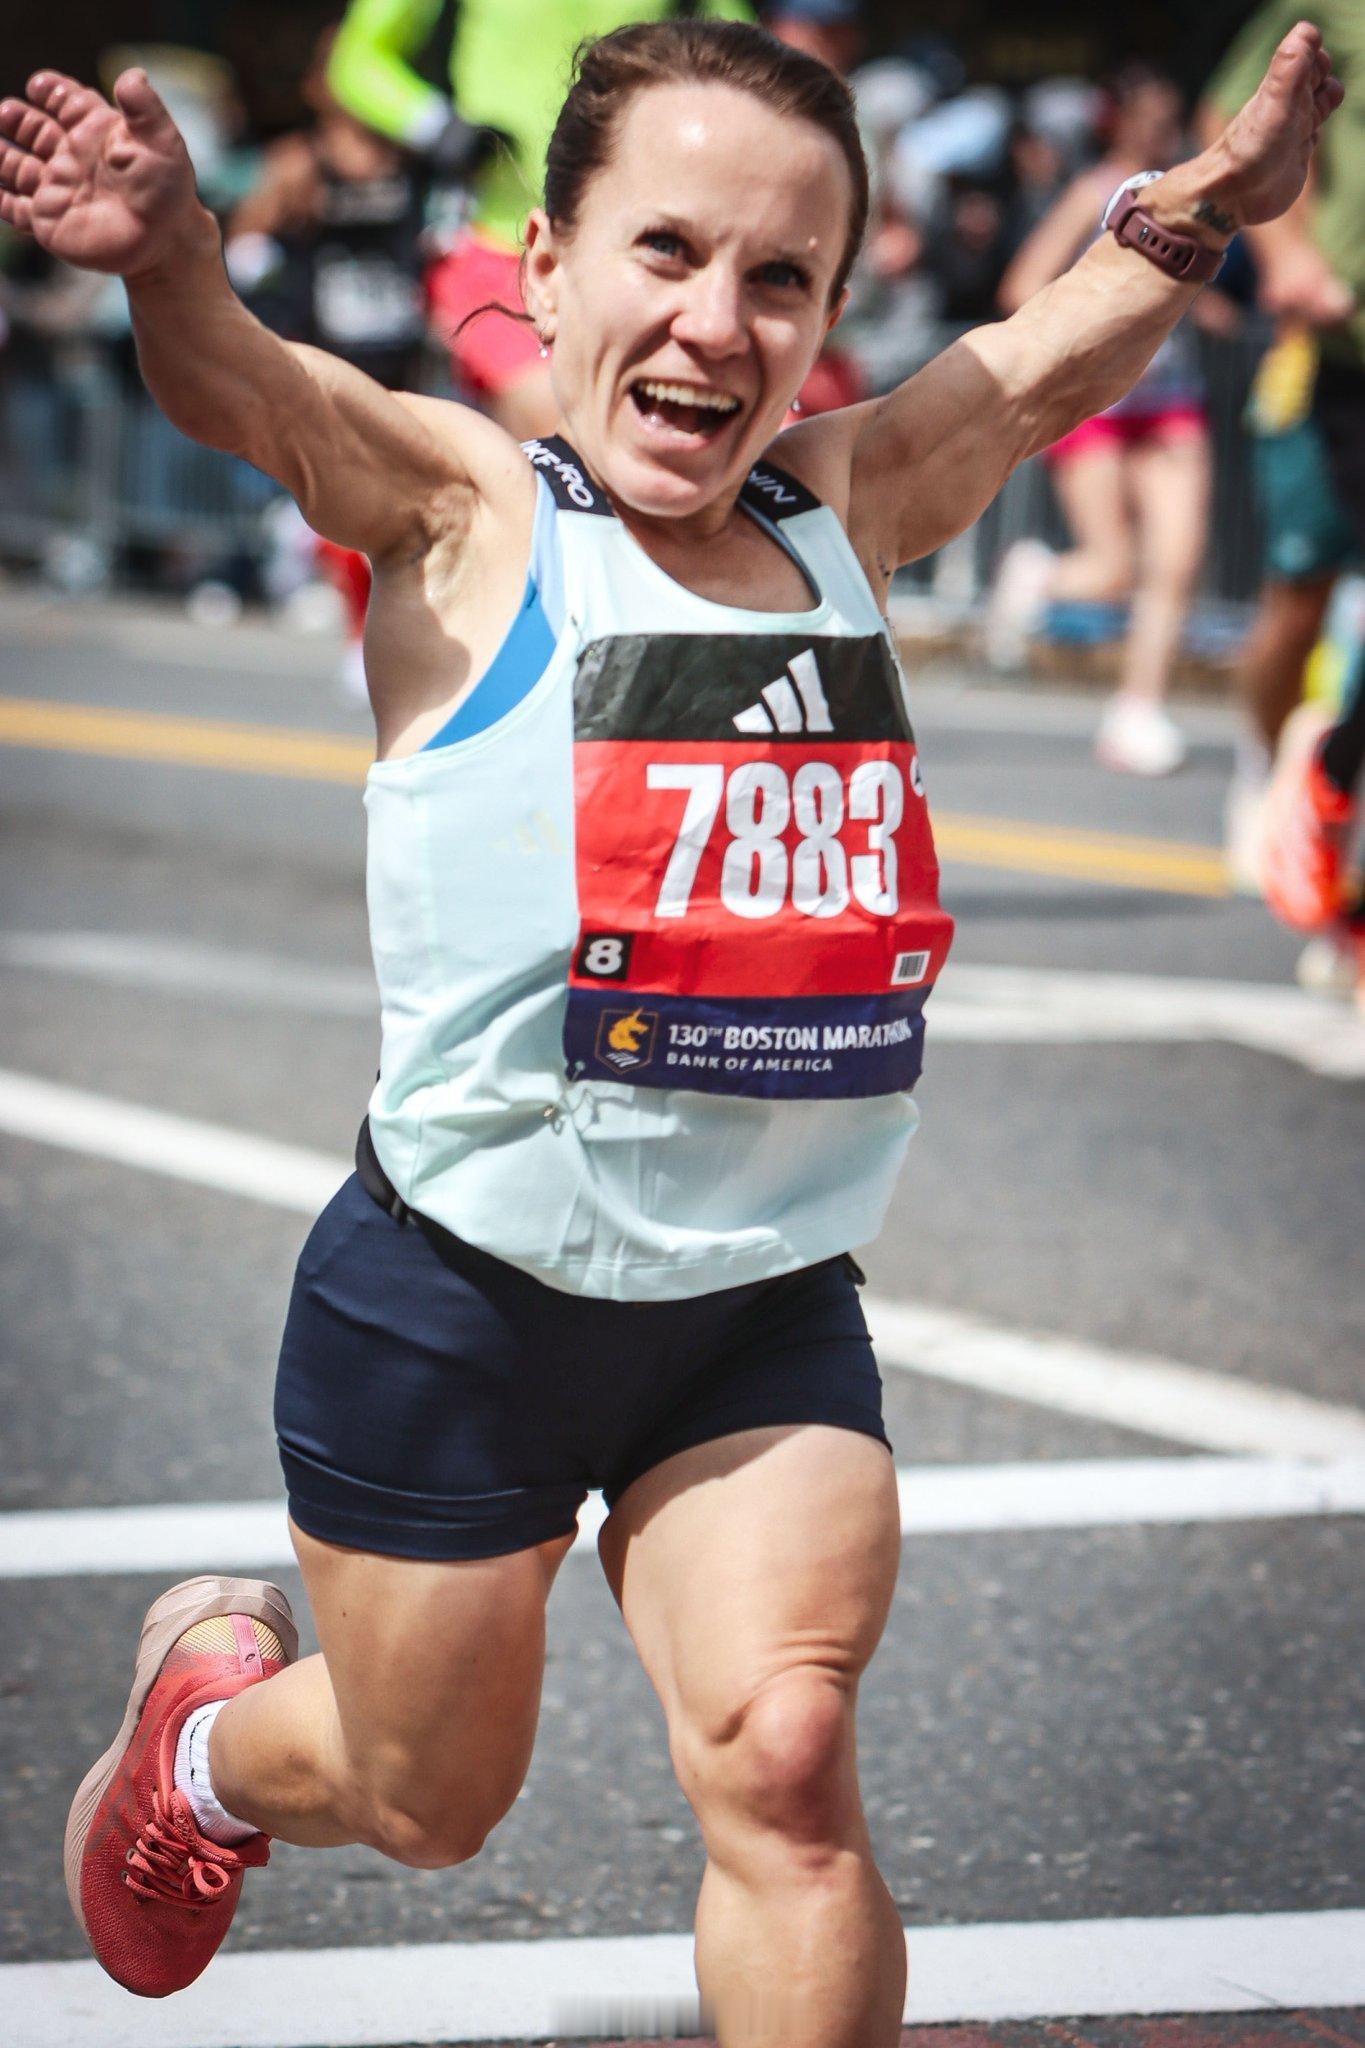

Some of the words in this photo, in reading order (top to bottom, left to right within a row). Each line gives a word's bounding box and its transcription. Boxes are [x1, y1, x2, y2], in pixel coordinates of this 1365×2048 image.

[647, 761, 904, 919] 7883
[585, 938, 622, 975] 8
[724, 1025, 818, 1051] BOSTON
[666, 1052, 720, 1068] BANK
[724, 1057, 750, 1071] OF
[752, 1058, 833, 1072] AMERICA
